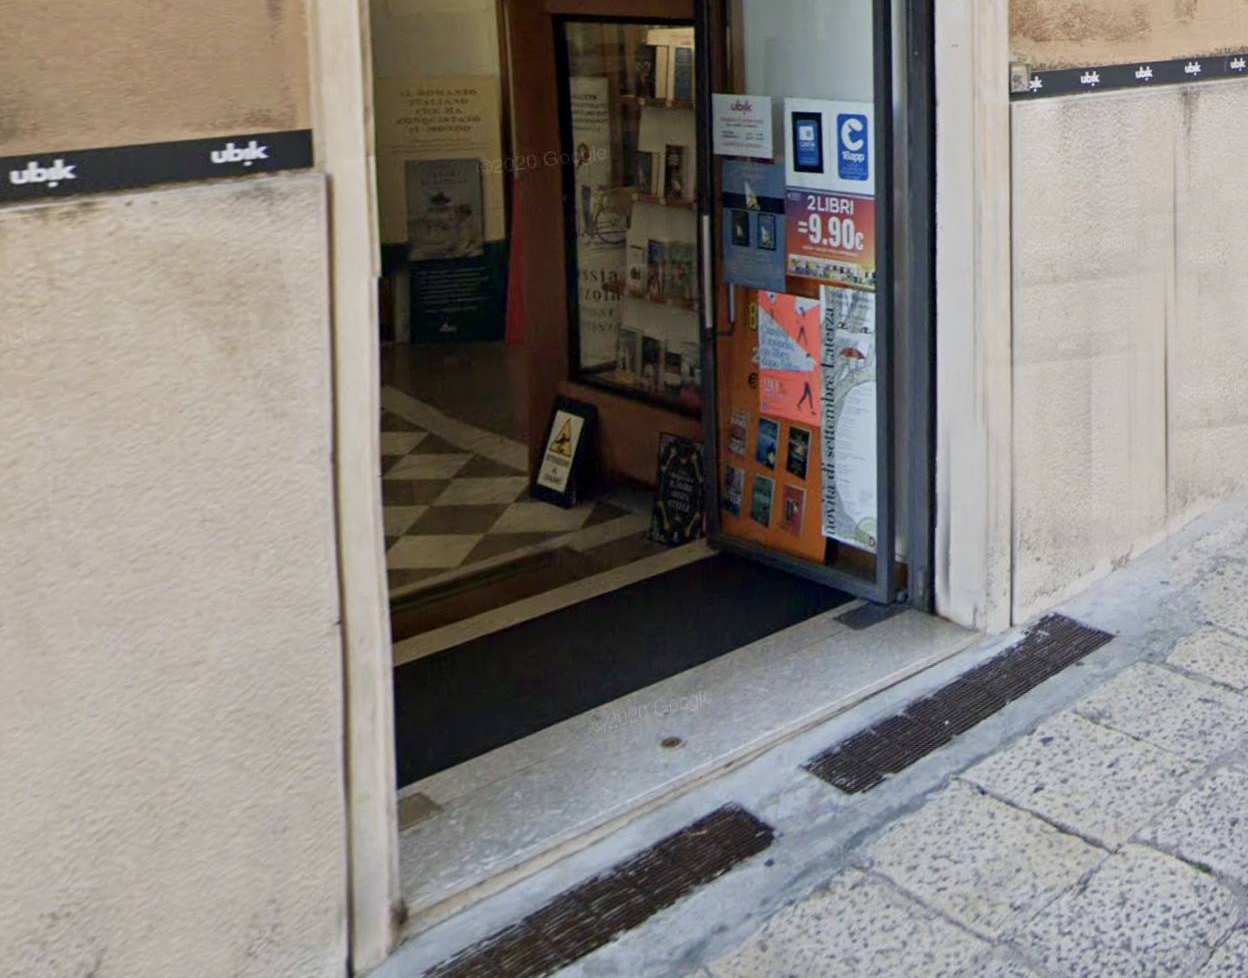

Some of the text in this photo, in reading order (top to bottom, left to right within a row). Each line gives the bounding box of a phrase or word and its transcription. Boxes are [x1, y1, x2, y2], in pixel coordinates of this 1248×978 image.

[1080, 71, 1100, 86] ubik
[1135, 66, 1153, 81] ubik
[730, 99, 753, 115] ubik
[9, 140, 269, 188] ubik ubik
[820, 307, 835, 369] Laterza
[821, 375, 835, 459] settembre
